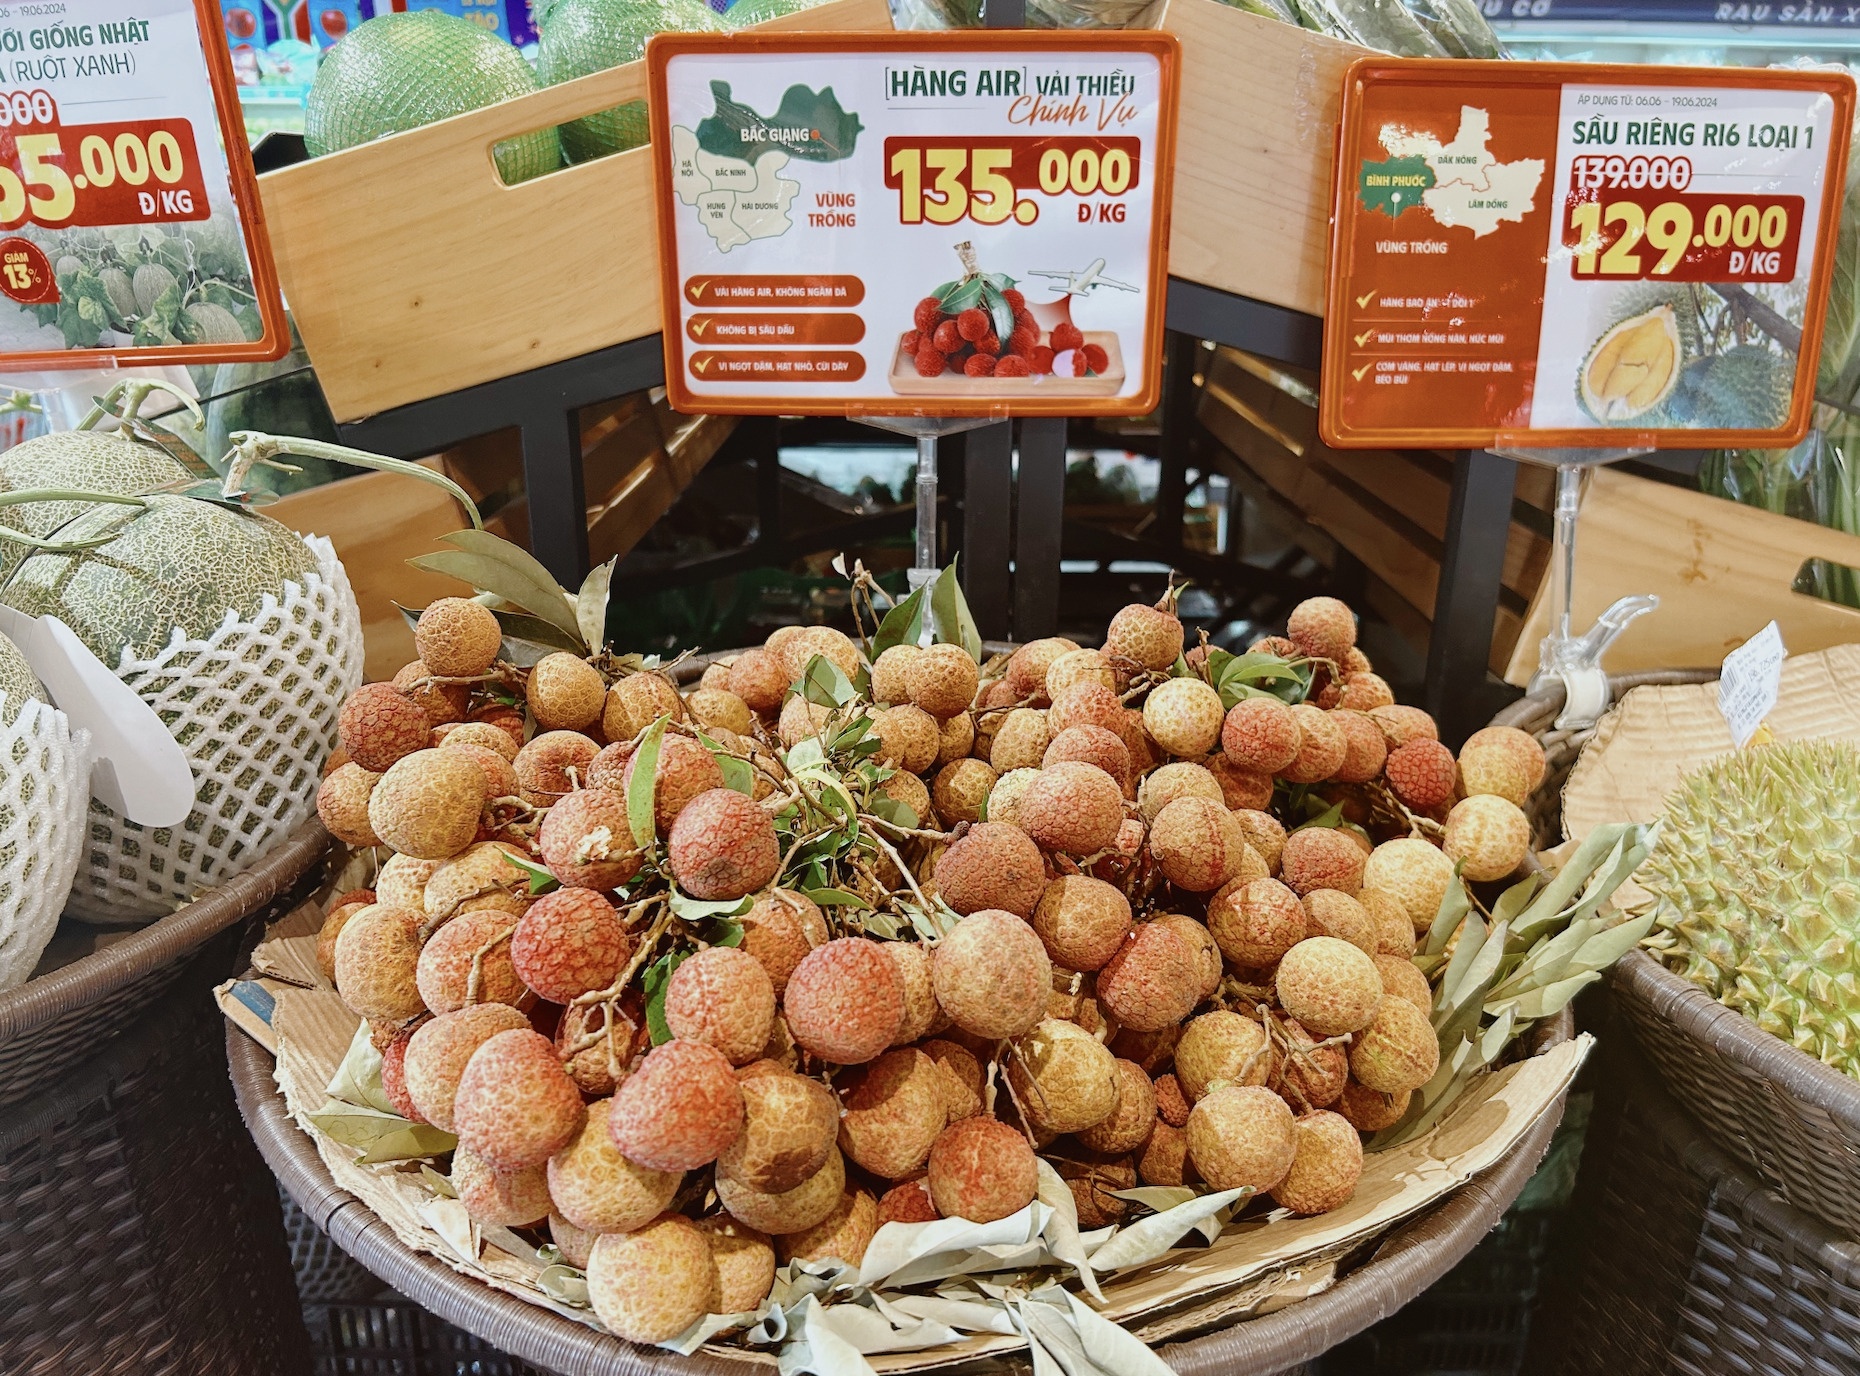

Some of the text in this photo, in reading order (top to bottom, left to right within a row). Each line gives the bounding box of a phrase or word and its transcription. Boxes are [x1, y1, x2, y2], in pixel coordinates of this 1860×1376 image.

[20, 3, 66, 16] 19.06.2024
[1715, 2, 1770, 21] RAU
[0, 17, 150, 53] ỚI GIỐNG NHẬT
[10, 54, 67, 85] (RUỘT
[76, 50, 136, 78] XANH)
[1036, 70, 1070, 96] VẢI
[1077, 68, 1135, 96] THIỀU
[1578, 93, 1590, 105] ÁP
[1635, 95, 1661, 106] 06.06
[1672, 96, 1718, 107] 19.06.2024
[1008, 90, 1138, 131] Chính Vụ
[741, 124, 810, 142] BẮC GIANG
[1572, 113, 1814, 152] SẦU RIÊNG RI6 LOẠI 1
[1455, 155, 1477, 164] NÔNG
[1366, 174, 1389, 187] BÌNH
[1573, 156, 1691, 190] 139.000
[138, 189, 194, 217] Đ/KG
[816, 191, 855, 208] VÙNG
[808, 210, 856, 227] TRỒNG
[1078, 202, 1126, 225] Đ/KG
[1375, 239, 1448, 254] VÙNG TRỒNG
[1570, 201, 1788, 275] 129.000
[1729, 249, 1781, 276] Đ/KG
[731, 286, 755, 297] HÀNG
[776, 286, 805, 297] KHÔNG
[717, 325, 746, 335] KHÔNG
